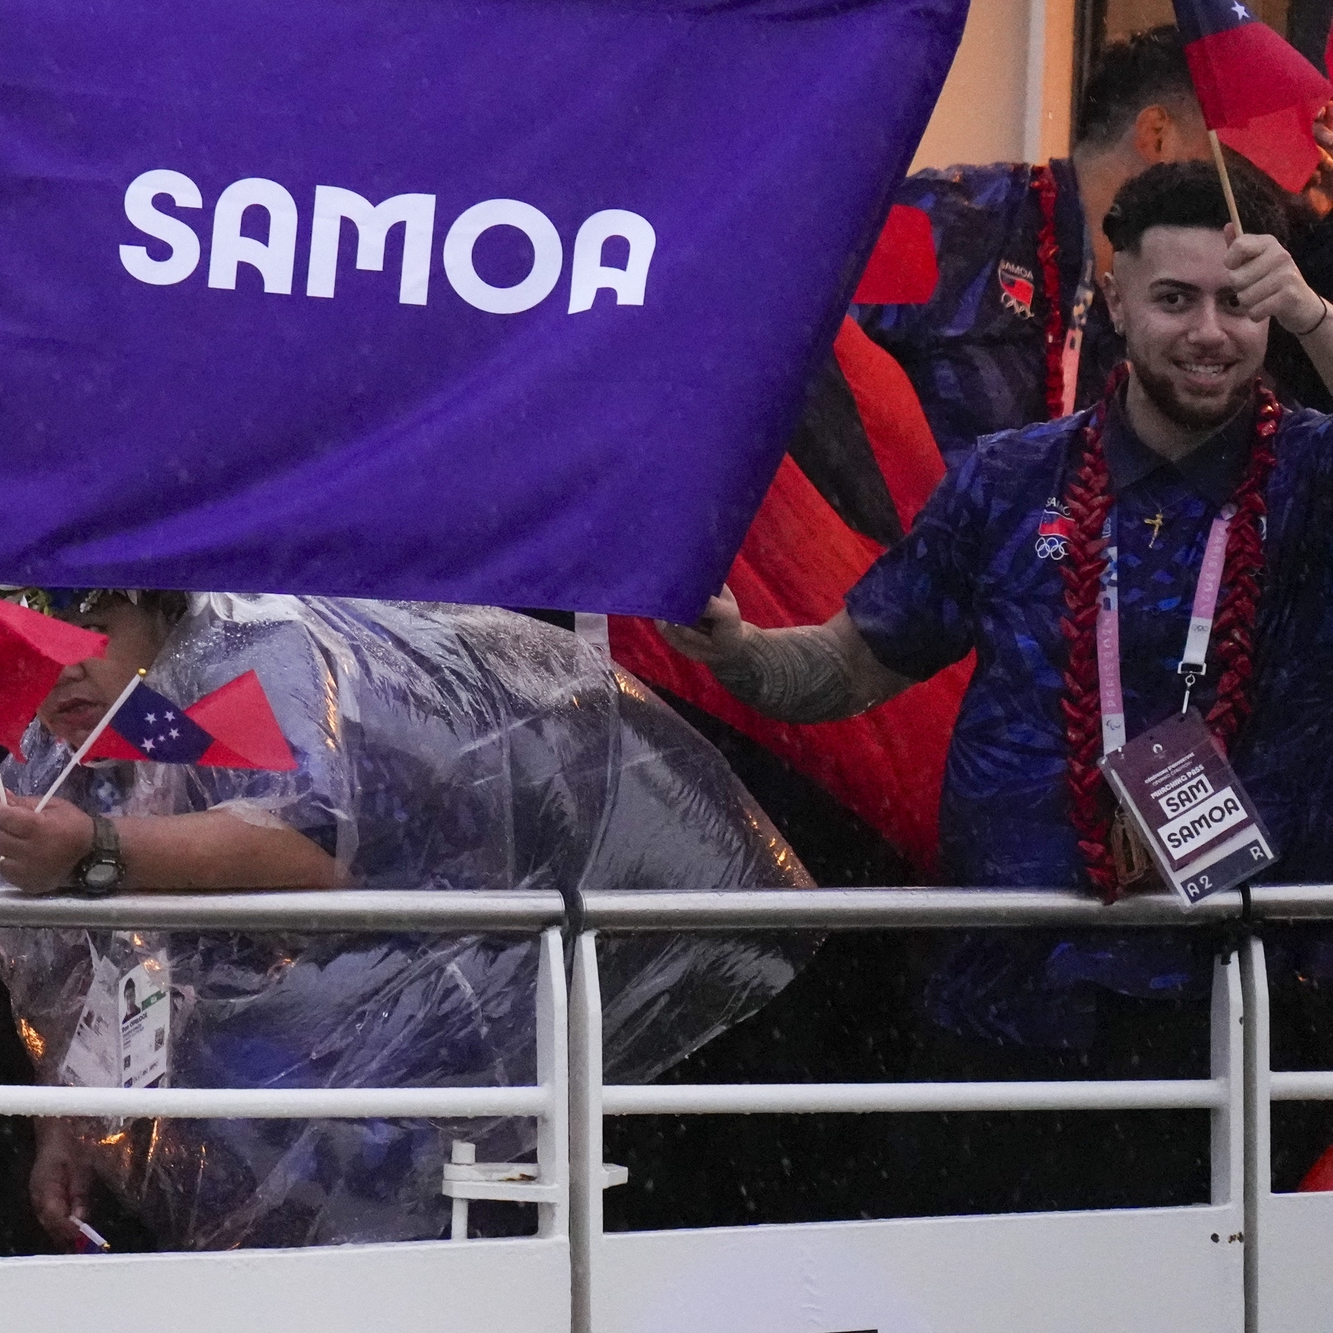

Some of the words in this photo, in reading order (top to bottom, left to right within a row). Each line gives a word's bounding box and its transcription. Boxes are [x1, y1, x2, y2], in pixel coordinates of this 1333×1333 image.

[118, 168, 657, 316] SAMOA
[1150, 775, 1188, 799] MARCHING
[1186, 764, 1205, 778] PASS
[1165, 778, 1209, 813] SAM
[1166, 797, 1240, 849] SAMOA
[1186, 882, 1200, 897] A
[1199, 875, 1213, 889] 2
[1250, 846, 1265, 861] R
